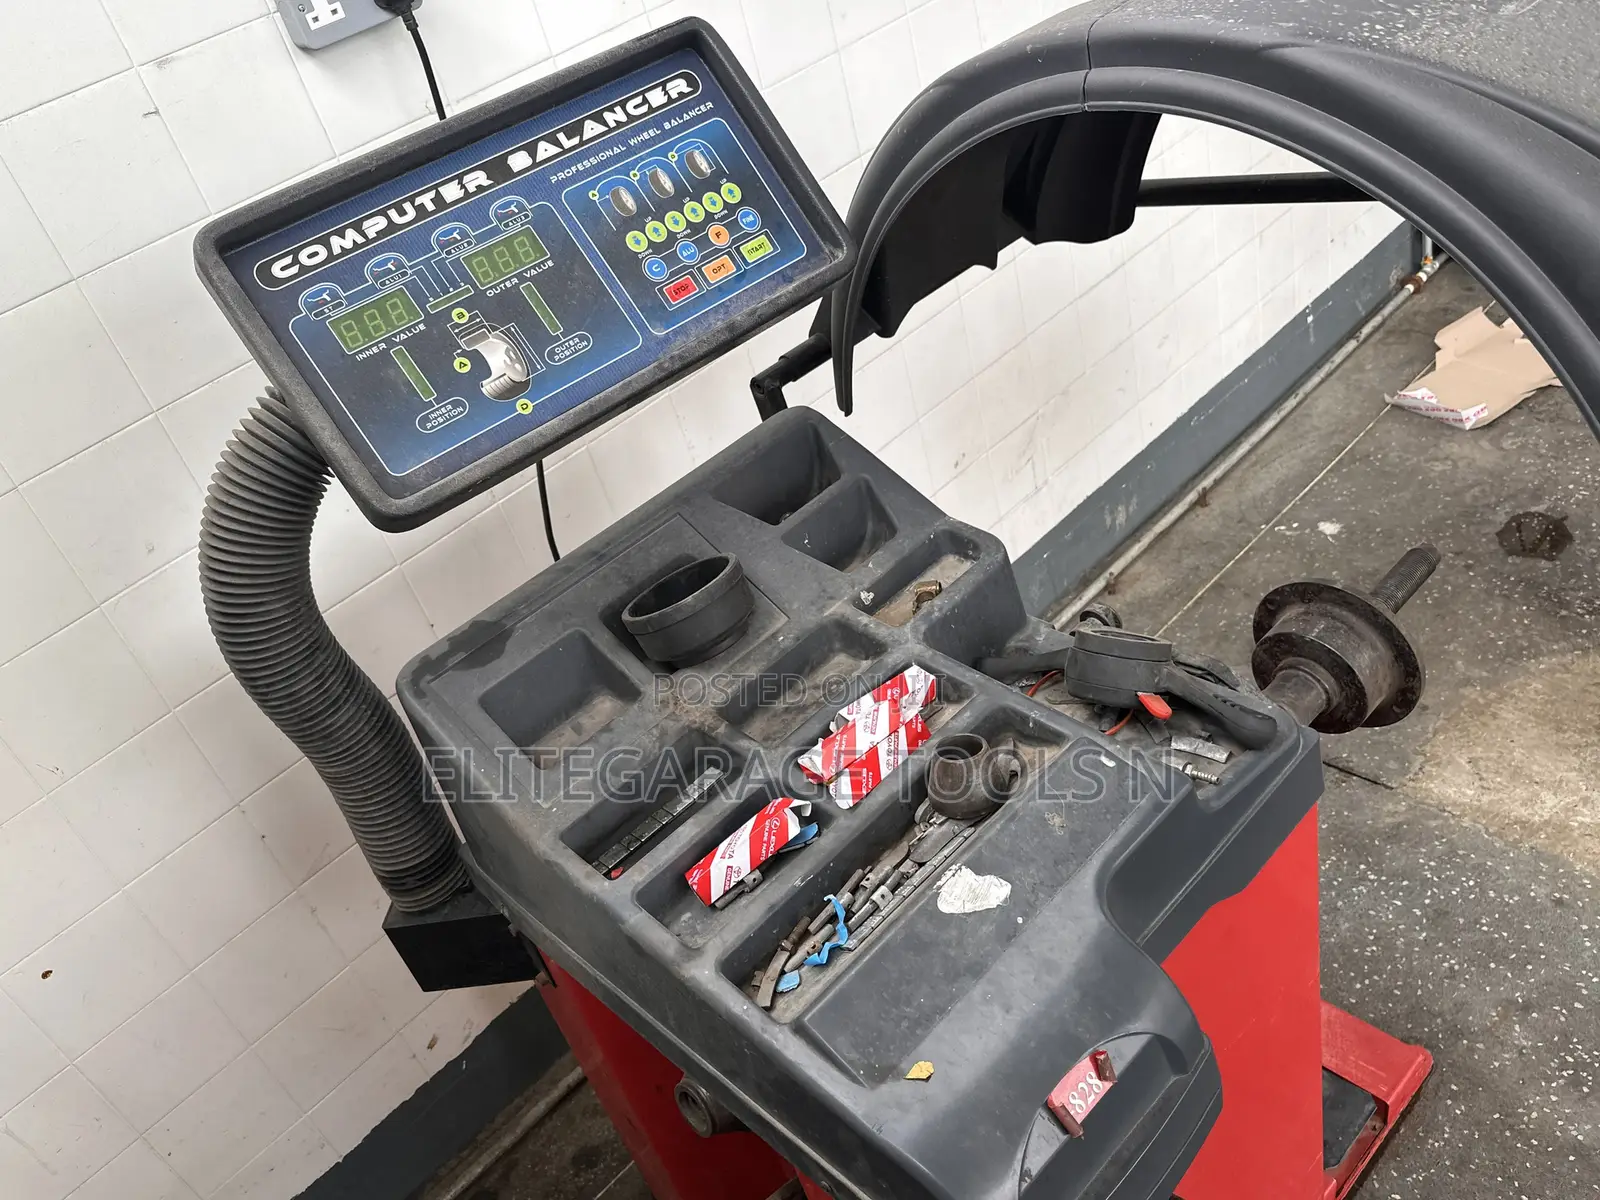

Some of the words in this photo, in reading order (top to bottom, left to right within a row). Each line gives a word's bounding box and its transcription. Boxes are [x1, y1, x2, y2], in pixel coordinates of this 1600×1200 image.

[550, 143, 627, 183] PROFESSIONAL
[628, 126, 661, 146] WHEEL
[663, 101, 714, 130] BALANCER
[270, 170, 495, 279] COMPUTER
[507, 77, 694, 172] BALANCER
[715, 231, 722, 239] F
[682, 246, 695, 257] ALU
[486, 277, 519, 298] OUTER
[523, 259, 555, 278] VALUE
[712, 263, 726, 275] OPT
[673, 284, 690, 296] STOP
[355, 342, 388, 362] INNER
[391, 323, 427, 344] VALUE
[554, 339, 580, 354] OUTER
[554, 340, 588, 363] POSITION
[425, 405, 464, 430] POSITION
[428, 404, 453, 420] INNER
